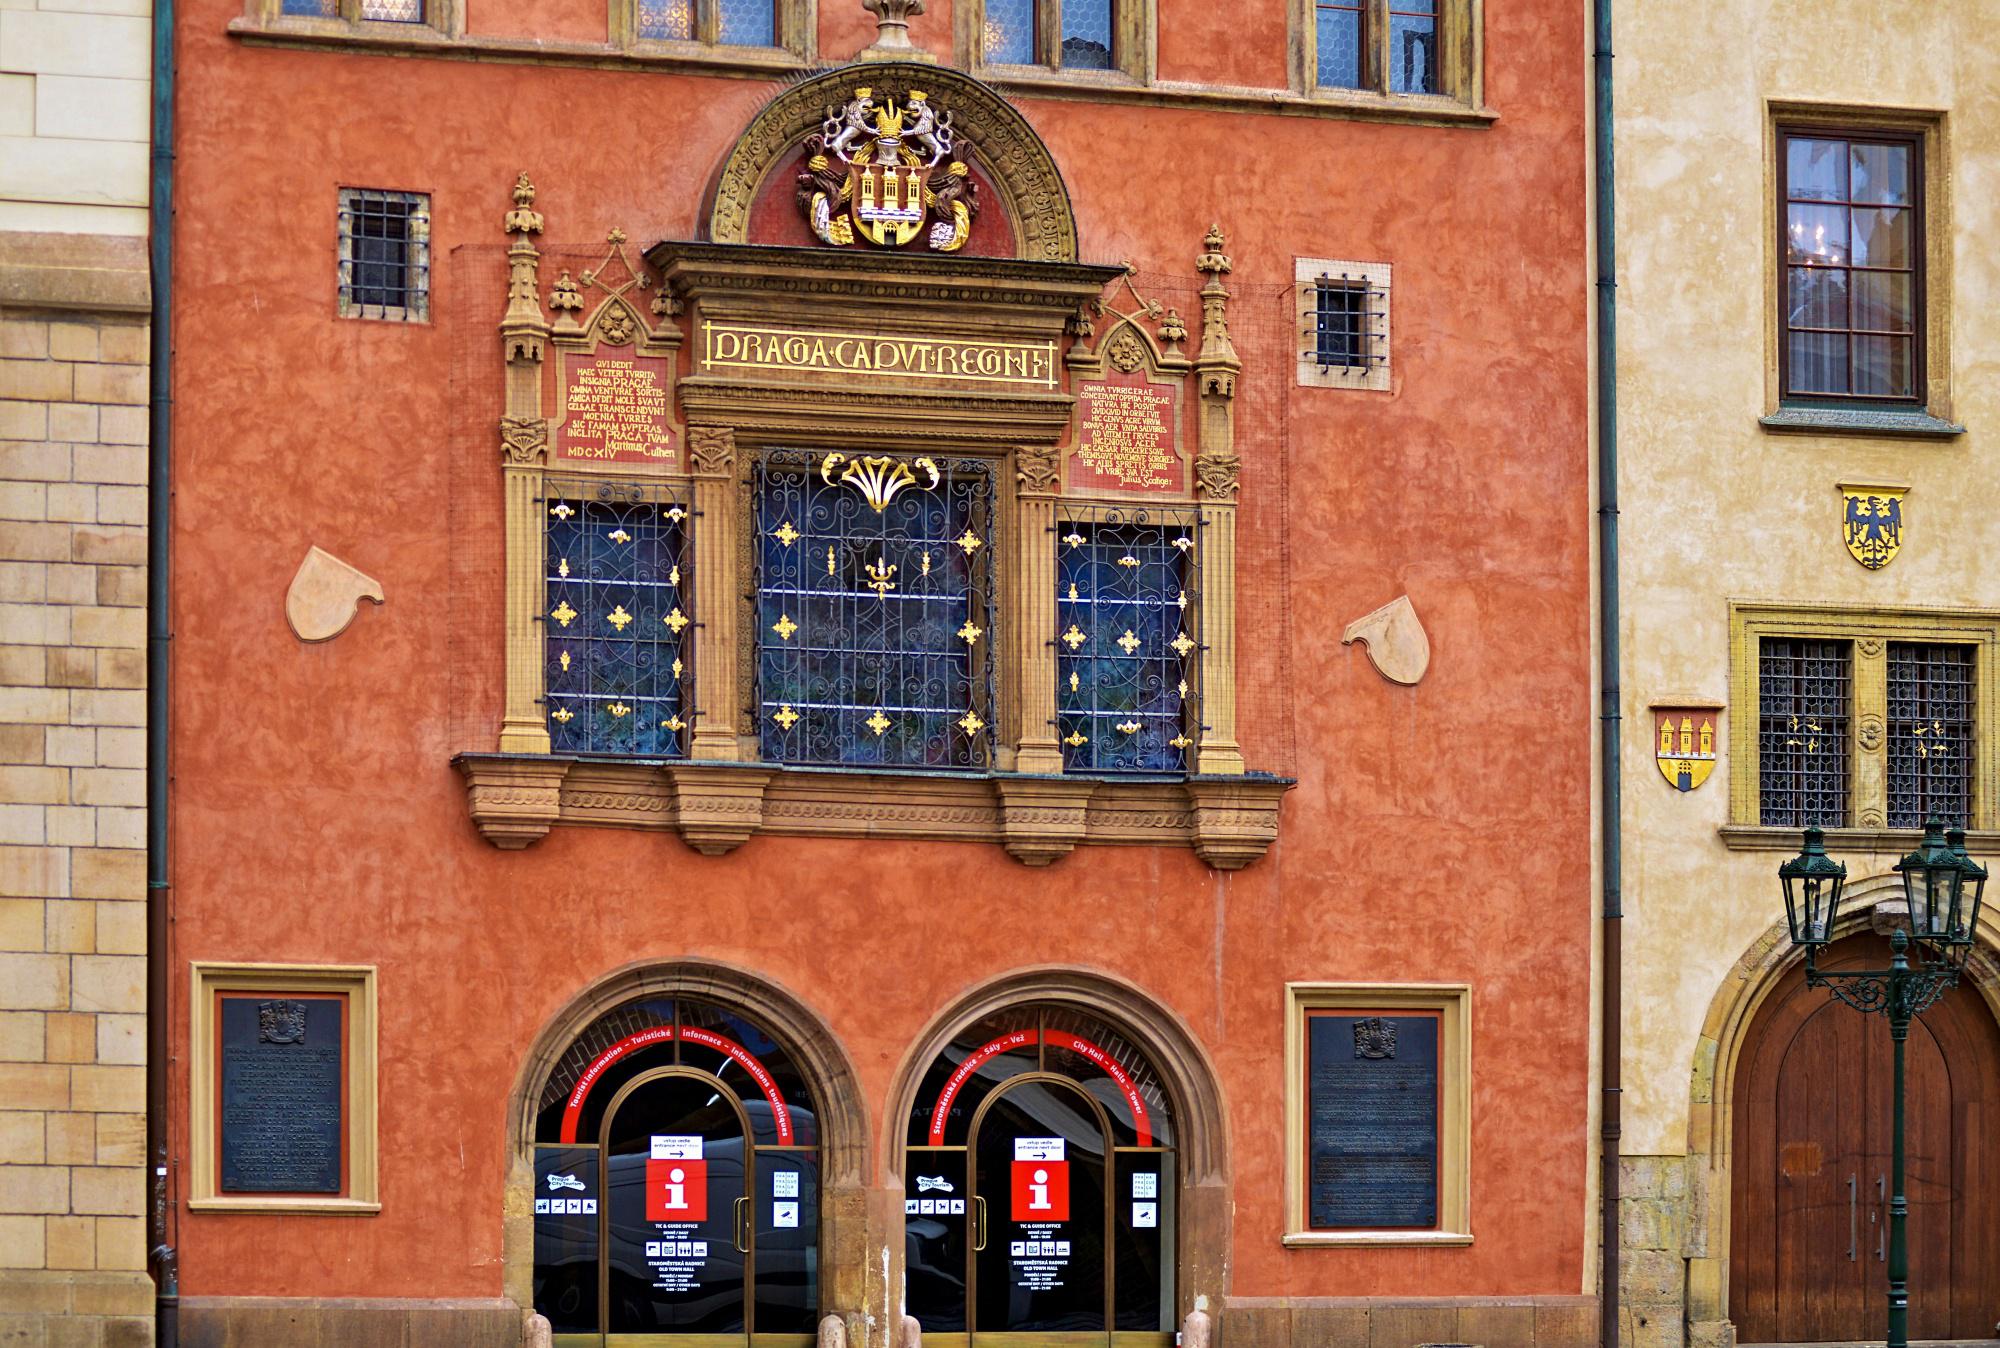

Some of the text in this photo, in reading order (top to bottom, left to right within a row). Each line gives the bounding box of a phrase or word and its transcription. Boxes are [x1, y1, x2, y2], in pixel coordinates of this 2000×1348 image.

[715, 332, 830, 367] PRAGA
[577, 368, 656, 379] HAEC VETERI TVRRITA
[580, 377, 612, 387] INSIGNIA
[594, 386, 634, 396] VENTVRAE
[1084, 385, 1106, 393] OMNIA
[615, 396, 635, 404] MOLE
[1119, 394, 1141, 402] OPPIDA
[599, 404, 665, 416] TRANSCENDVNT
[1092, 400, 1117, 408] NATVRA
[1134, 403, 1156, 411] POSVIT
[583, 412, 652, 423] MOENIA TVRRES
[572, 420, 662, 433] SIC FAMAM SVPERAS
[1083, 421, 1104, 430] BONVS
[1105, 423, 1118, 431] AER
[568, 428, 602, 438] INCLITA
[646, 434, 669, 444] TVAM
[1093, 444, 1118, 452] CAESAR
[1148, 455, 1174, 463] SORORES
[1116, 461, 1145, 469] SPRETIS
[570, 1080, 588, 1107] Tourist
[585, 1047, 623, 1082] information
[631, 1029, 671, 1044] Turistické
[682, 1029, 722, 1046] informace
[769, 1088, 788, 1136] touristiques
[934, 1082, 957, 1135] Staroměstská
[955, 1059, 977, 1082] radnice
[984, 1043, 1001, 1055] Sály
[1073, 1040, 1088, 1052] City
[1088, 1048, 1104, 1062] Hall
[1110, 1065, 1126, 1084] Halls
[1129, 1091, 1142, 1114] Tower
